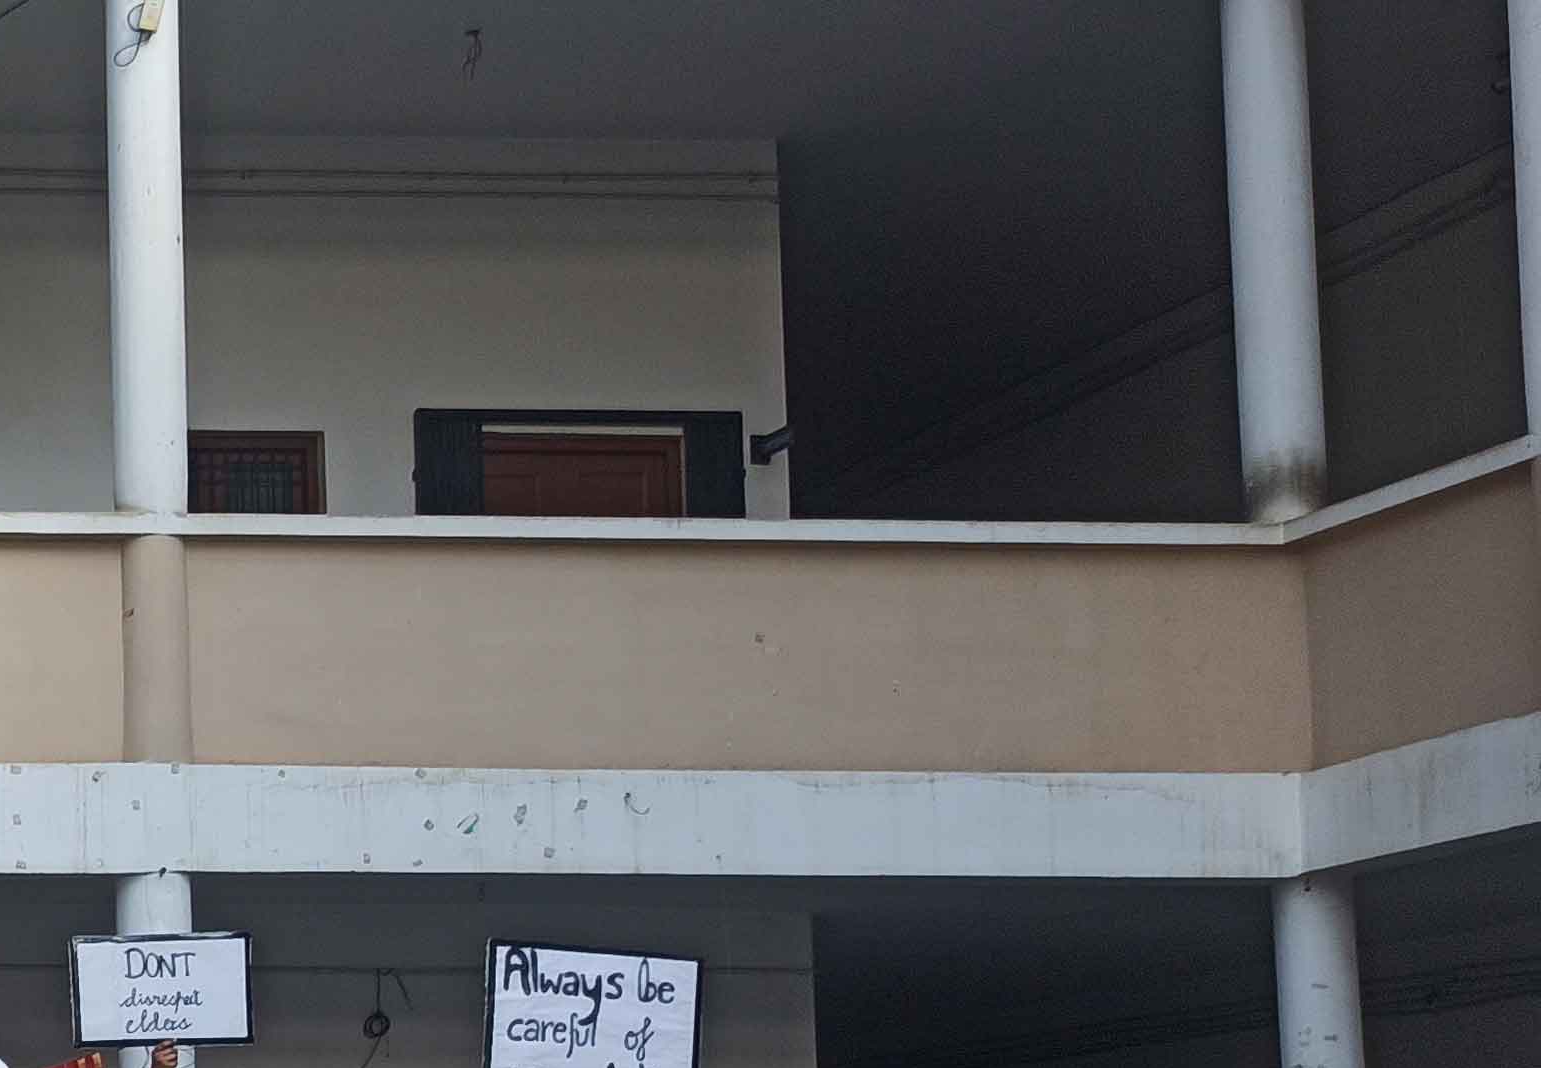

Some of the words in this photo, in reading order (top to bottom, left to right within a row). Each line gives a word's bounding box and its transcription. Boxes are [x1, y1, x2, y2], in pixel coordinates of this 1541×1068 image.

[119, 987, 203, 1013] disrespect
[503, 947, 625, 1026] Always
[637, 957, 676, 1004] be
[125, 1009, 193, 1034] elders
[506, 1012, 597, 1058] careful
[624, 1016, 656, 1061] of
